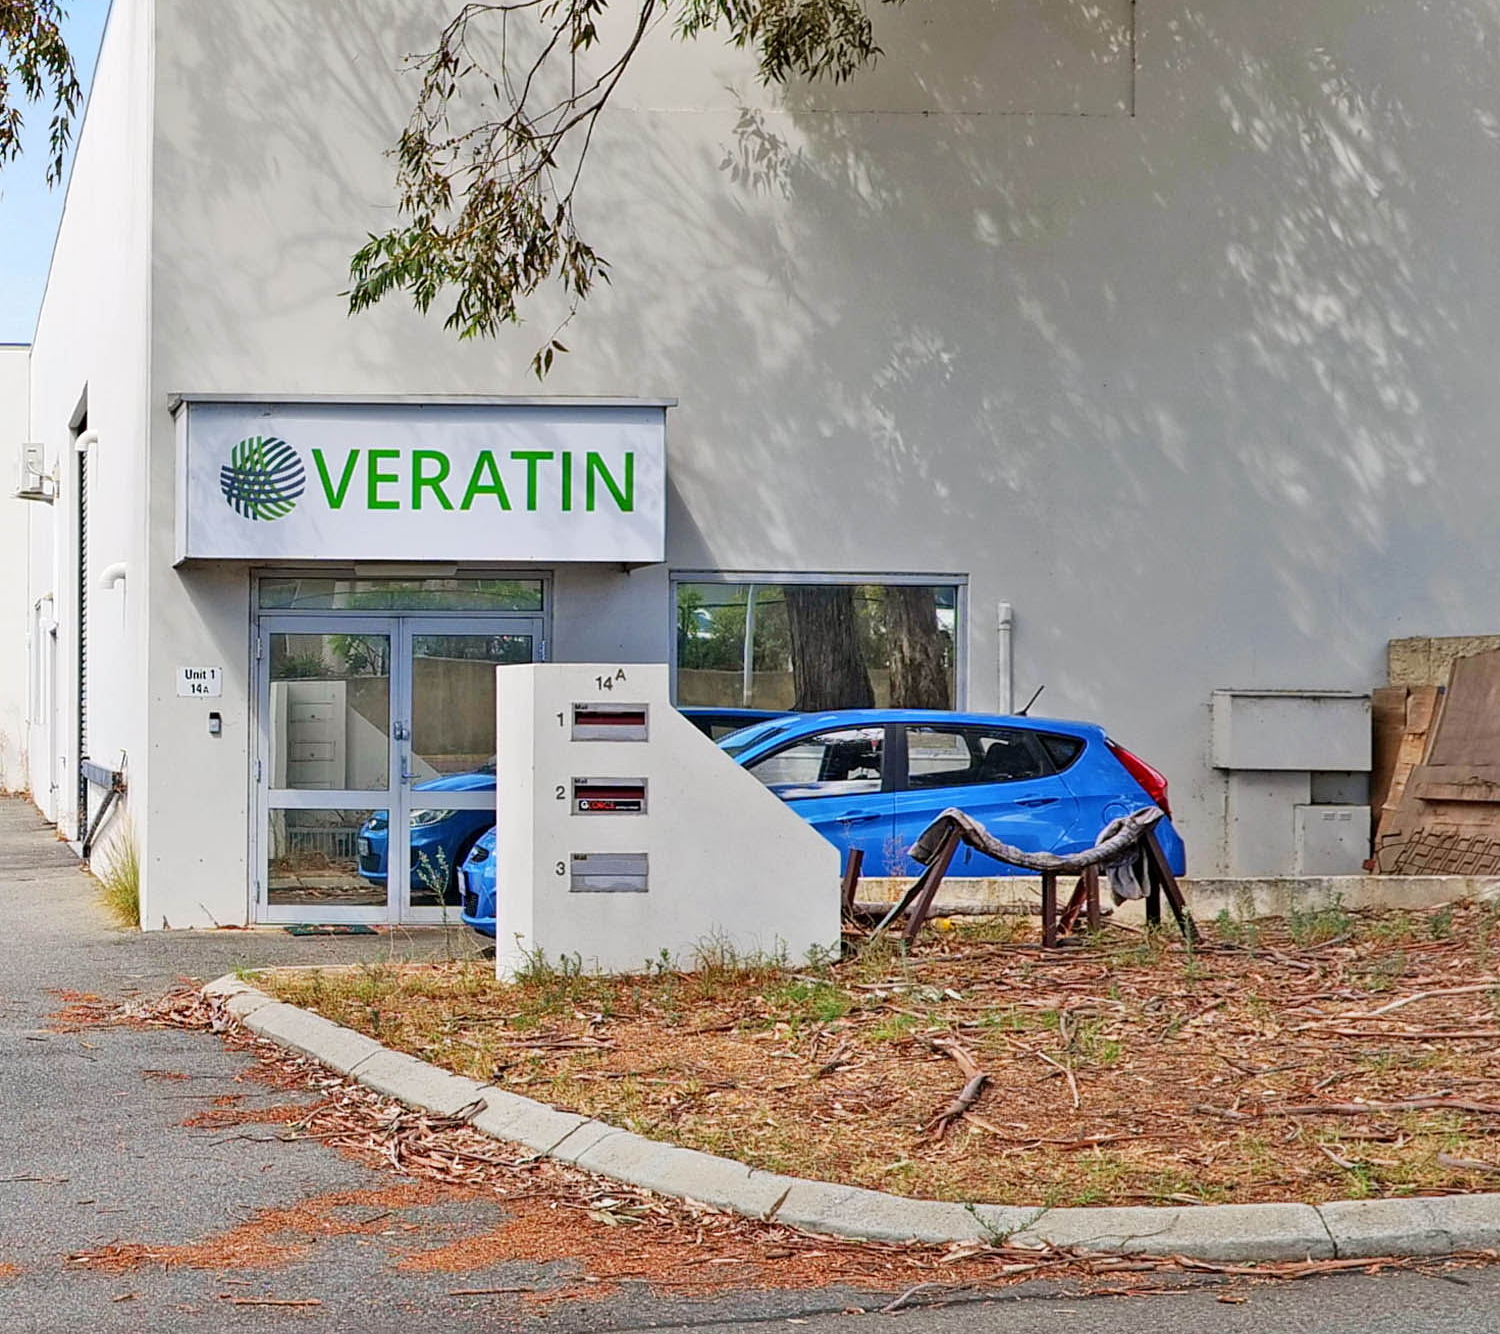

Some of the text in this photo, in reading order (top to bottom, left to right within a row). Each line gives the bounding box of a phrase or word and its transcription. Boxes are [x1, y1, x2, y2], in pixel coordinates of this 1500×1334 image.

[311, 448, 635, 513] VERATIN
[185, 669, 215, 680] Unit 1
[556, 712, 564, 727] 1
[555, 785, 566, 800] 2
[555, 861, 566, 876] 3
